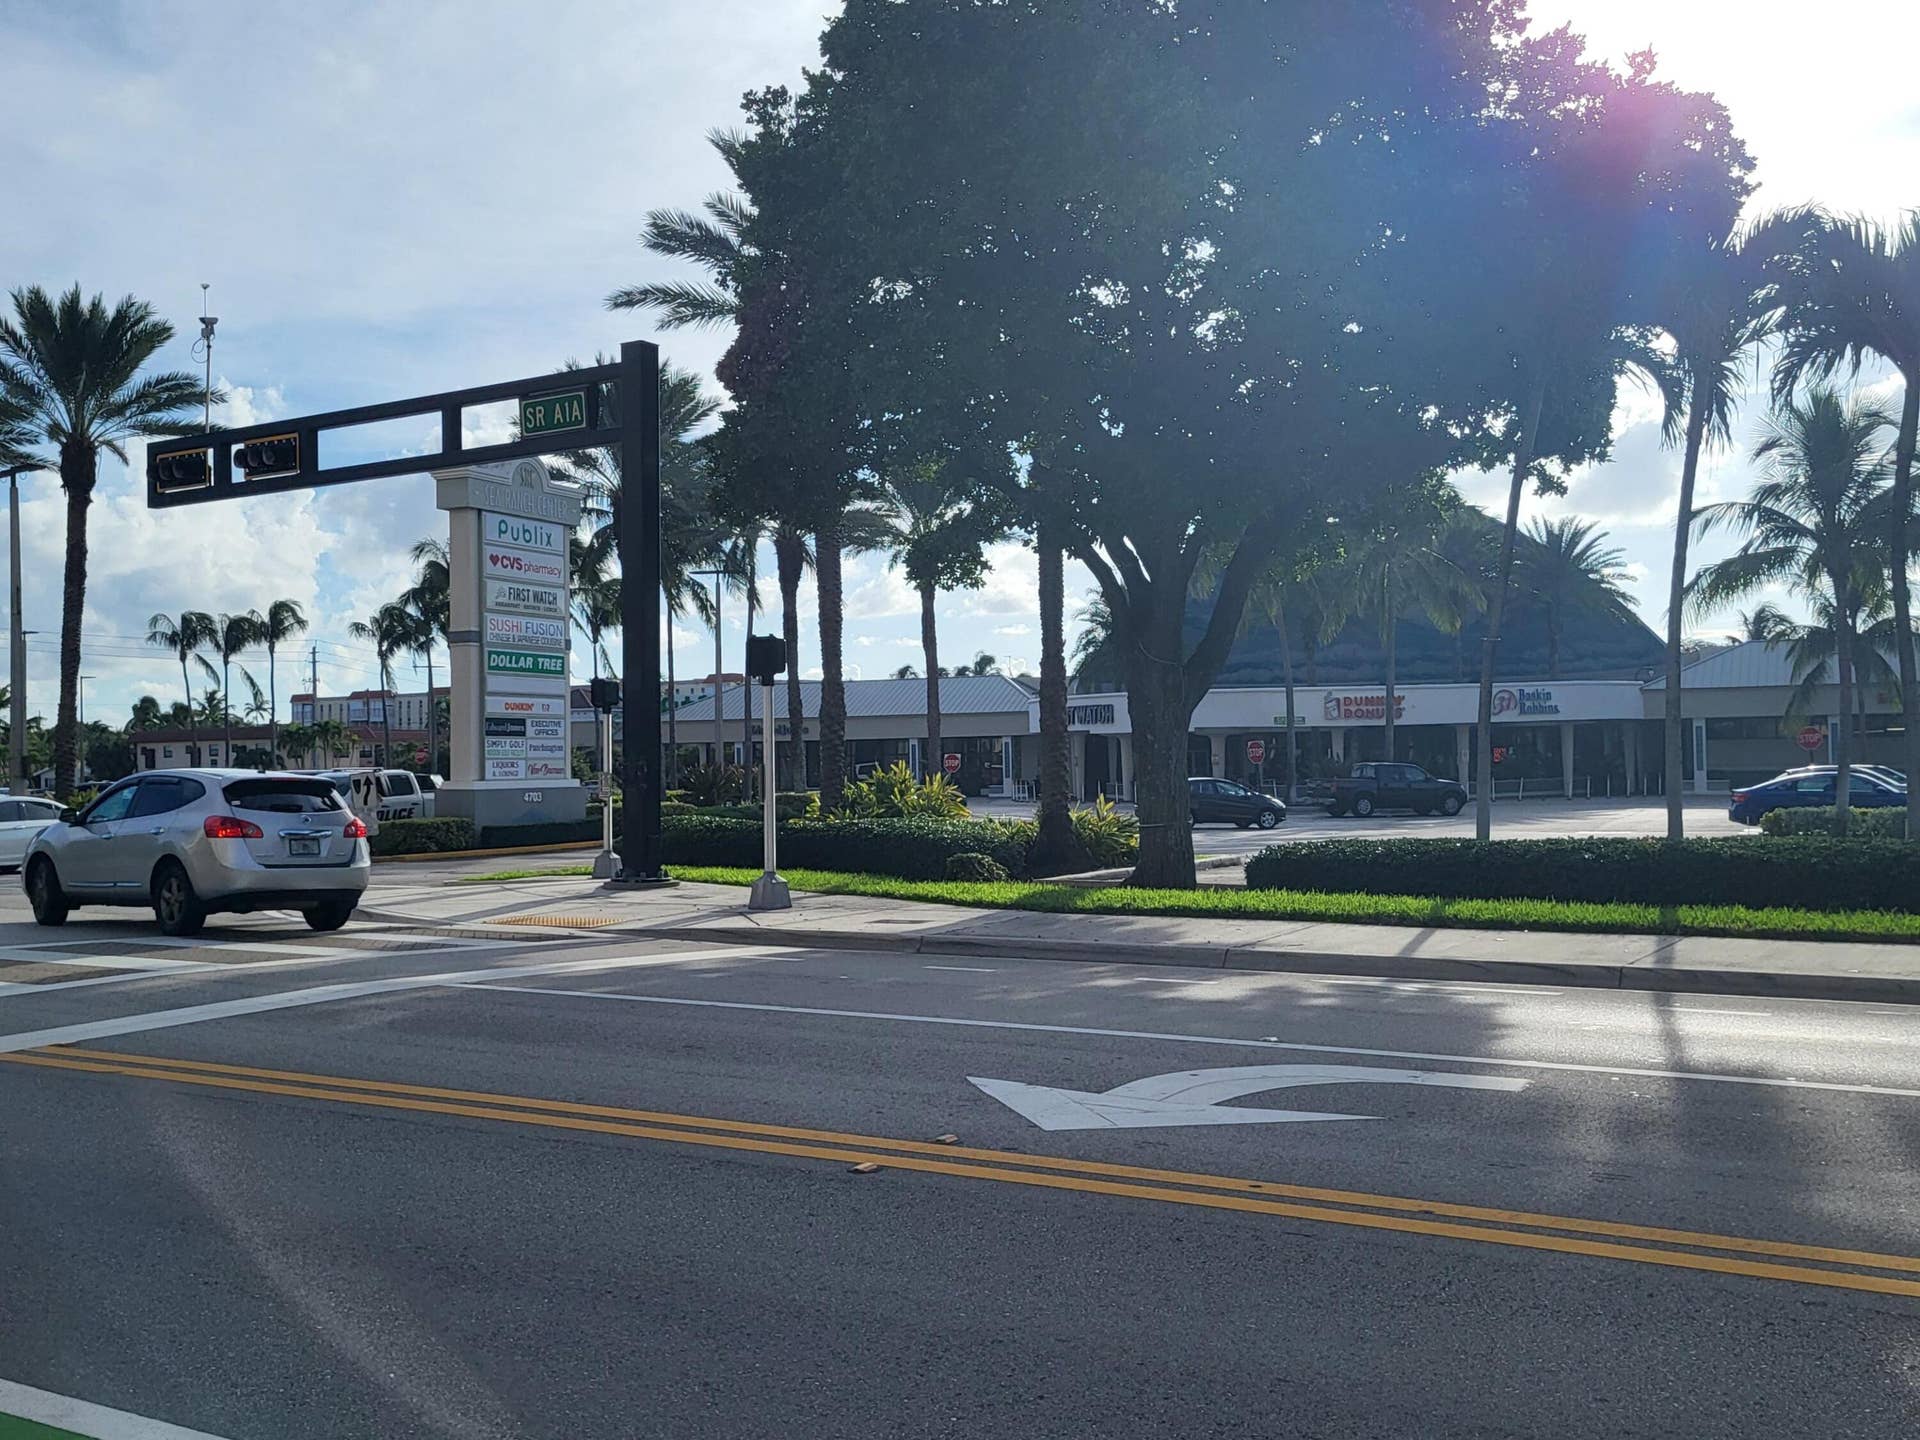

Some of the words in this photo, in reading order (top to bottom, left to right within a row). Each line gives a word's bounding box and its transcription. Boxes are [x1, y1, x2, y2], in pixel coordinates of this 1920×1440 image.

[526, 406, 545, 428] SR
[554, 400, 581, 425] A1A
[498, 519, 552, 547] Publix
[500, 555, 523, 571] CVS
[524, 562, 561, 579] pharmacy
[508, 586, 530, 602] FIRST
[532, 589, 558, 606] WATCH
[489, 618, 522, 633] SUSHI
[525, 621, 563, 638] FUSION
[490, 654, 533, 669] DOLLAR
[537, 656, 562, 671] TREE
[1517, 688, 1552, 703] Baskin
[1343, 708, 1403, 720] DONUS
[1518, 702, 1560, 715] Robbins
[531, 720, 562, 728] EXECUTIVE
[534, 728, 559, 736] OFFICES
[487, 739, 507, 748] SIMPLY
[509, 740, 524, 749] GOLF
[1800, 734, 1819, 743] STOP
[1249, 748, 1264, 757] STOP
[492, 761, 519, 770] LIQUORS
[944, 759, 959, 767] STOP
[523, 791, 543, 803] 4703
[376, 807, 415, 821] OLICE
